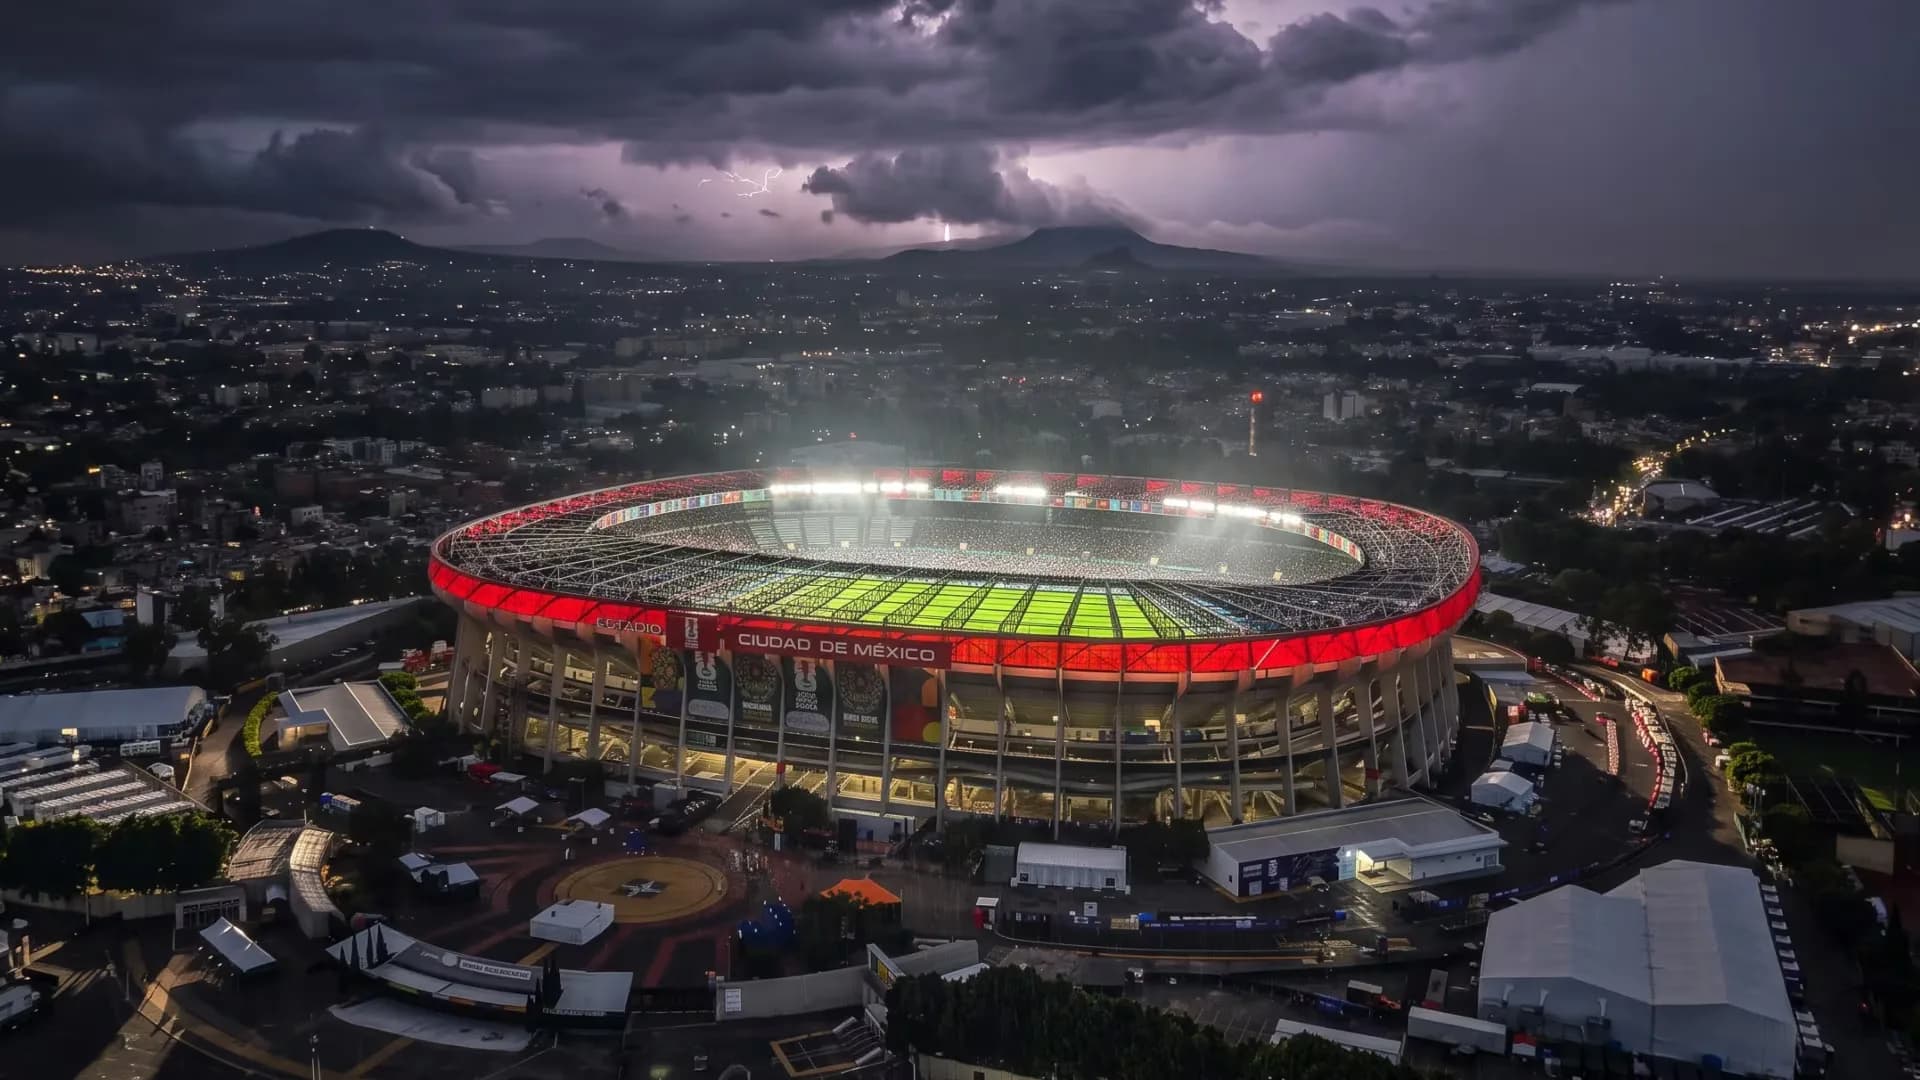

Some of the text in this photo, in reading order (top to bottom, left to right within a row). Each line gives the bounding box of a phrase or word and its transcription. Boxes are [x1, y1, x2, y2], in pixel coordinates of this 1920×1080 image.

[738, 633, 936, 662] CIUDAD DE MÉXICO
